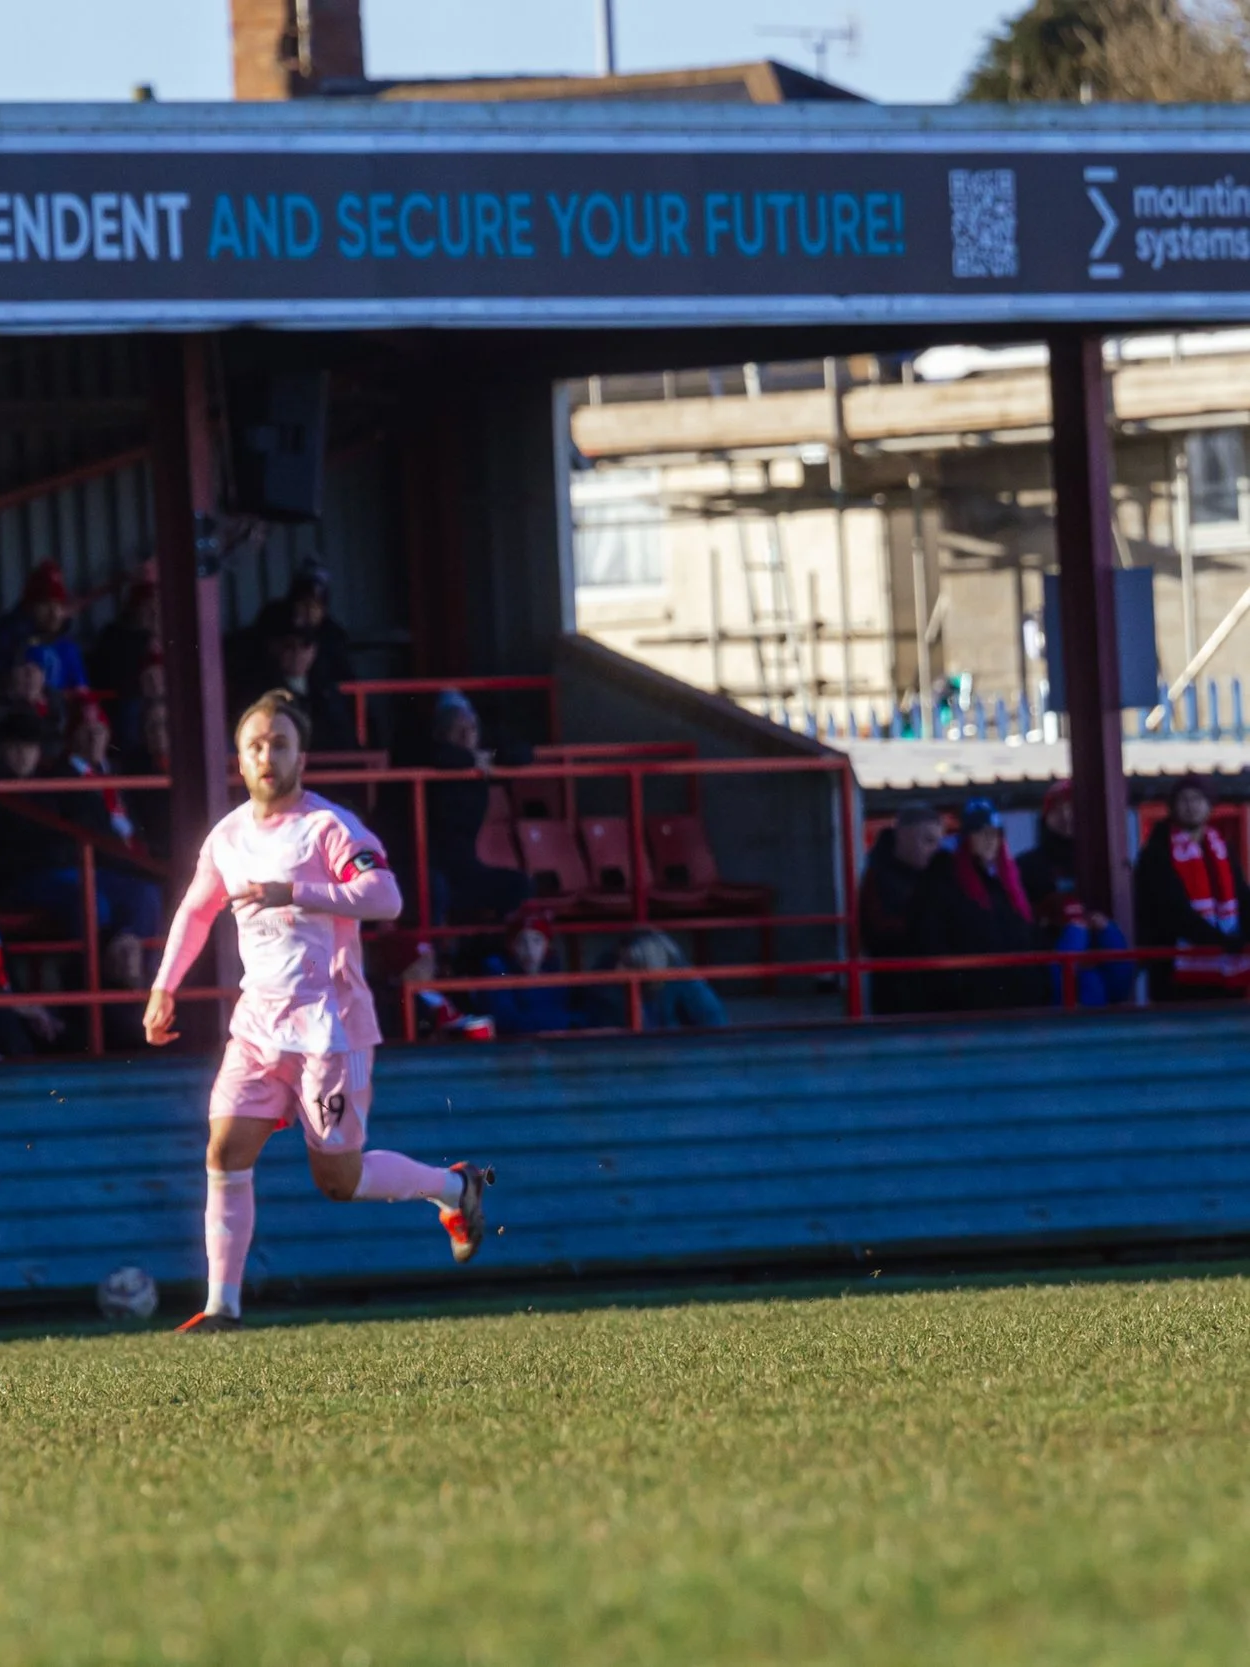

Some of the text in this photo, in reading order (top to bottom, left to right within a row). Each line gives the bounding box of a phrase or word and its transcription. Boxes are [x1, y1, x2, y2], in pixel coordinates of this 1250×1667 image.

[1132, 174, 1250, 219] mountin
[207, 192, 323, 261] AND
[336, 191, 536, 260] SECURE
[546, 190, 691, 259] YOUR
[703, 191, 907, 258] FUTURE!
[1135, 222, 1250, 270] systems
